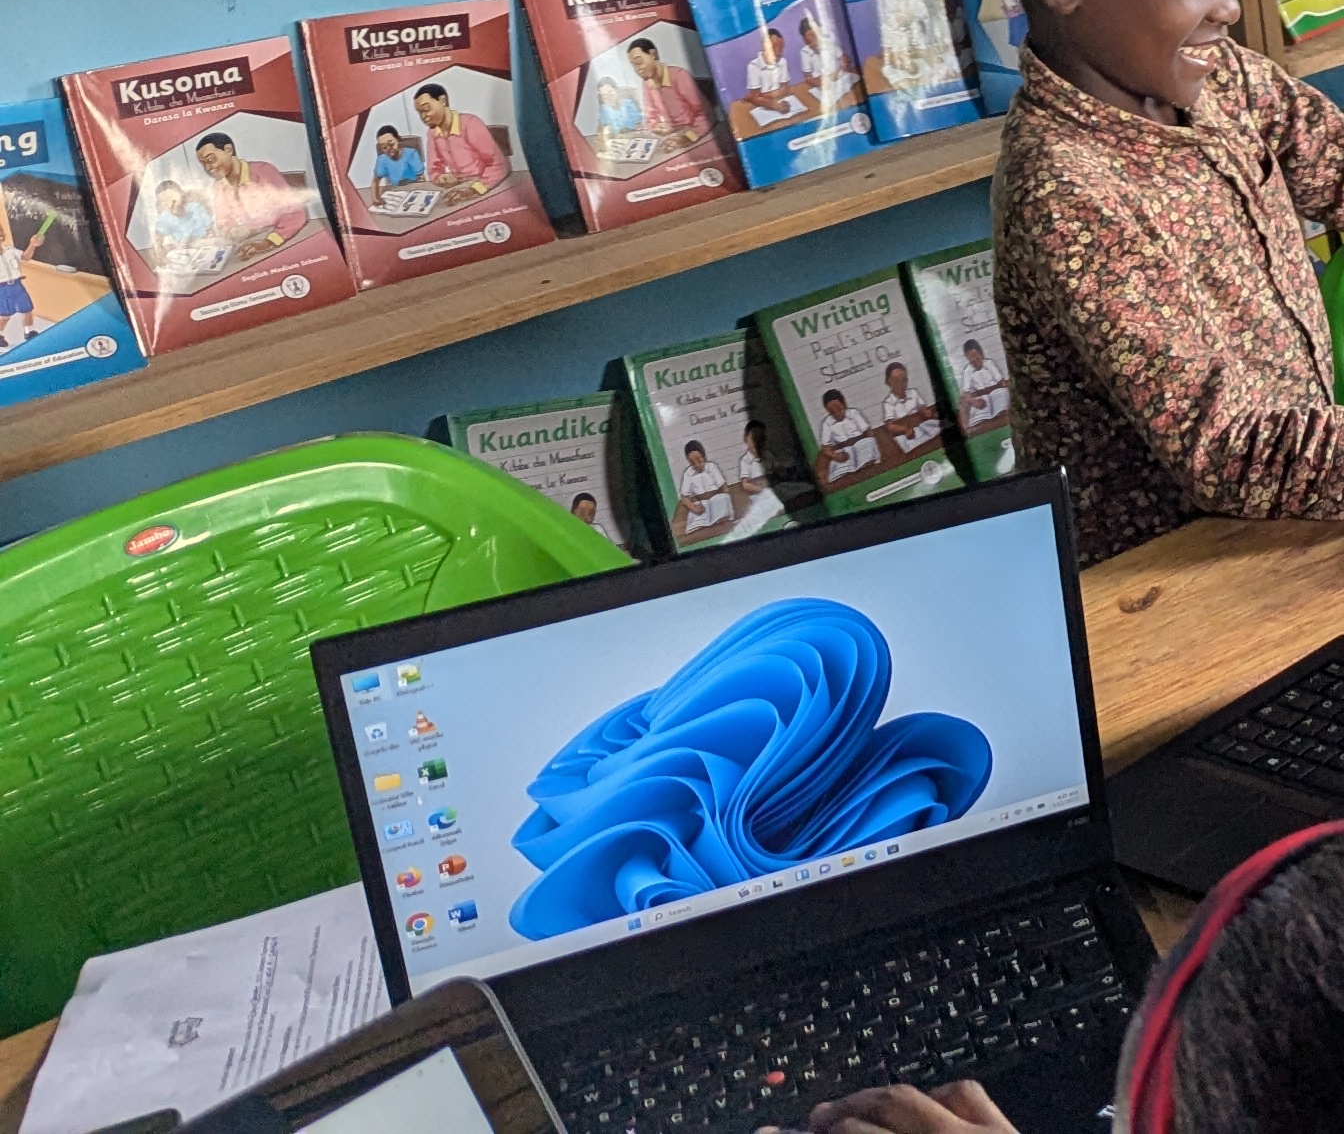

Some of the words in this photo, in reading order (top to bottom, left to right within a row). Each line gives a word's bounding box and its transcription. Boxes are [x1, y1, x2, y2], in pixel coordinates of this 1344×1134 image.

[351, 21, 462, 51] Kusoma
[118, 65, 244, 105] Kusoma
[143, 112, 181, 127] Darasa
[182, 108, 193, 119] la
[195, 101, 236, 116] Kwanza
[790, 293, 891, 339] Writing
[479, 415, 613, 454] Kuandika
